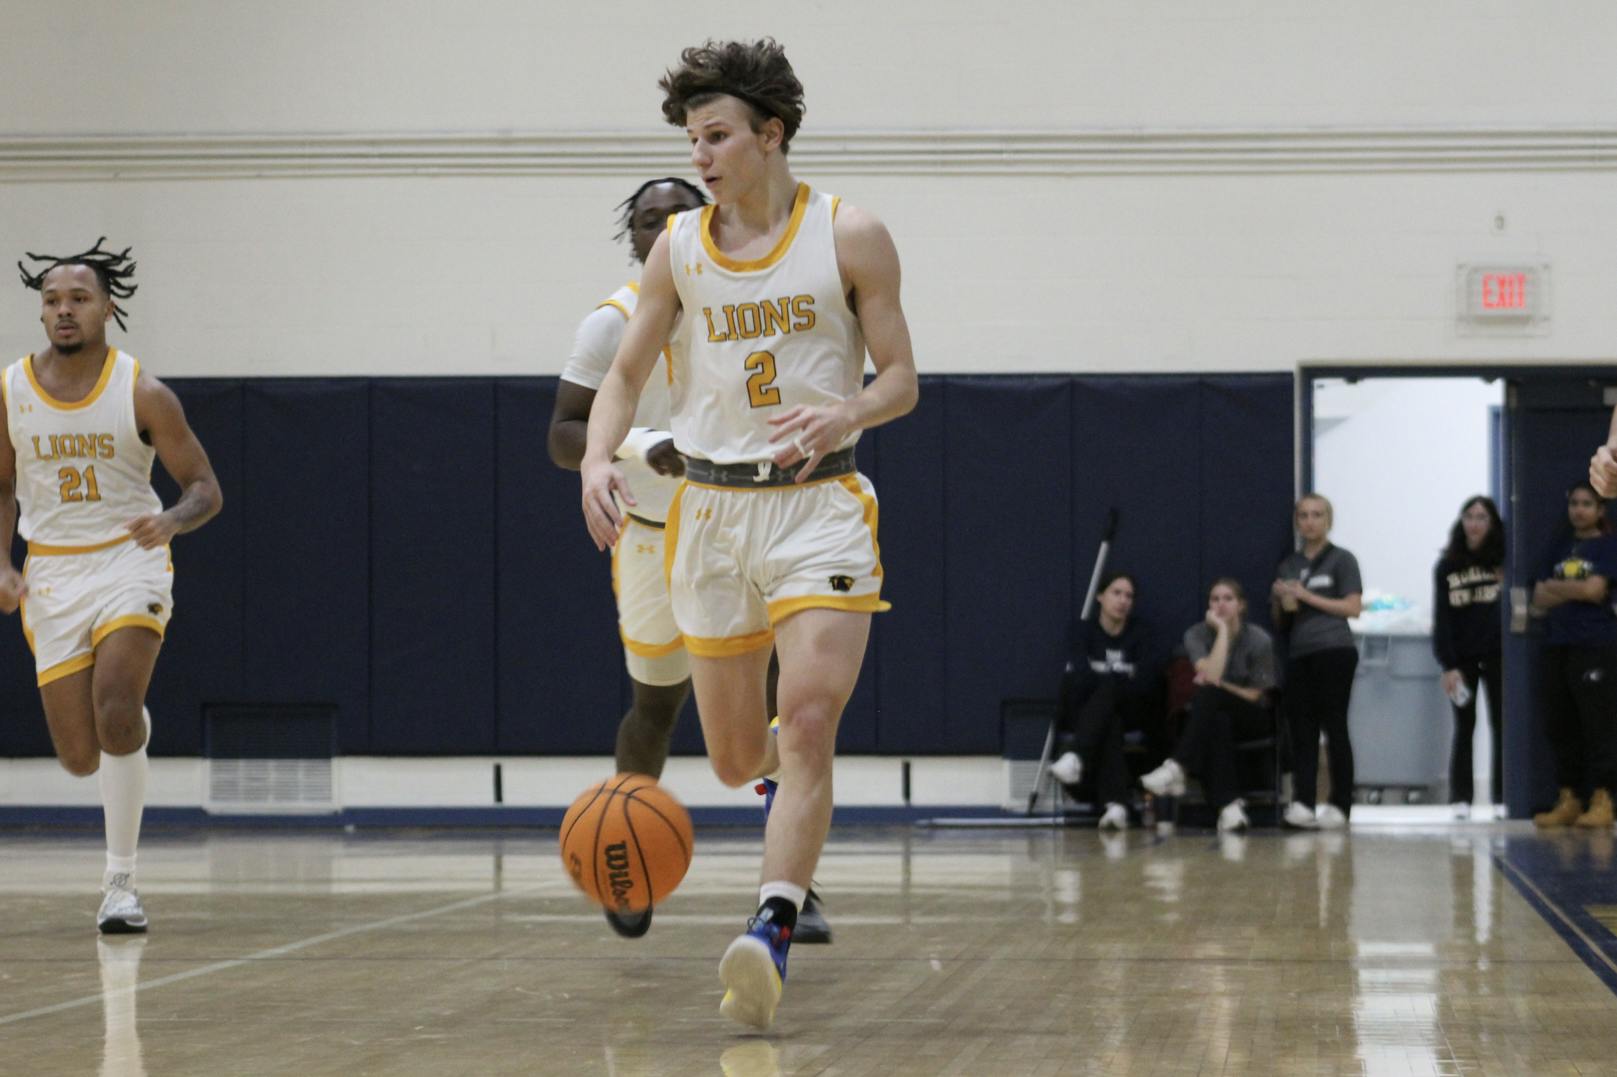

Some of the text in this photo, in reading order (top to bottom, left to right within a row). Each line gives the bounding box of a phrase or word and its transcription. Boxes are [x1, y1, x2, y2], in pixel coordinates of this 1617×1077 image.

[1481, 272, 1528, 310] EXIT
[702, 294, 816, 343] LIONS
[744, 350, 782, 409] 2
[32, 433, 115, 461] LIONS
[58, 464, 102, 504] 21
